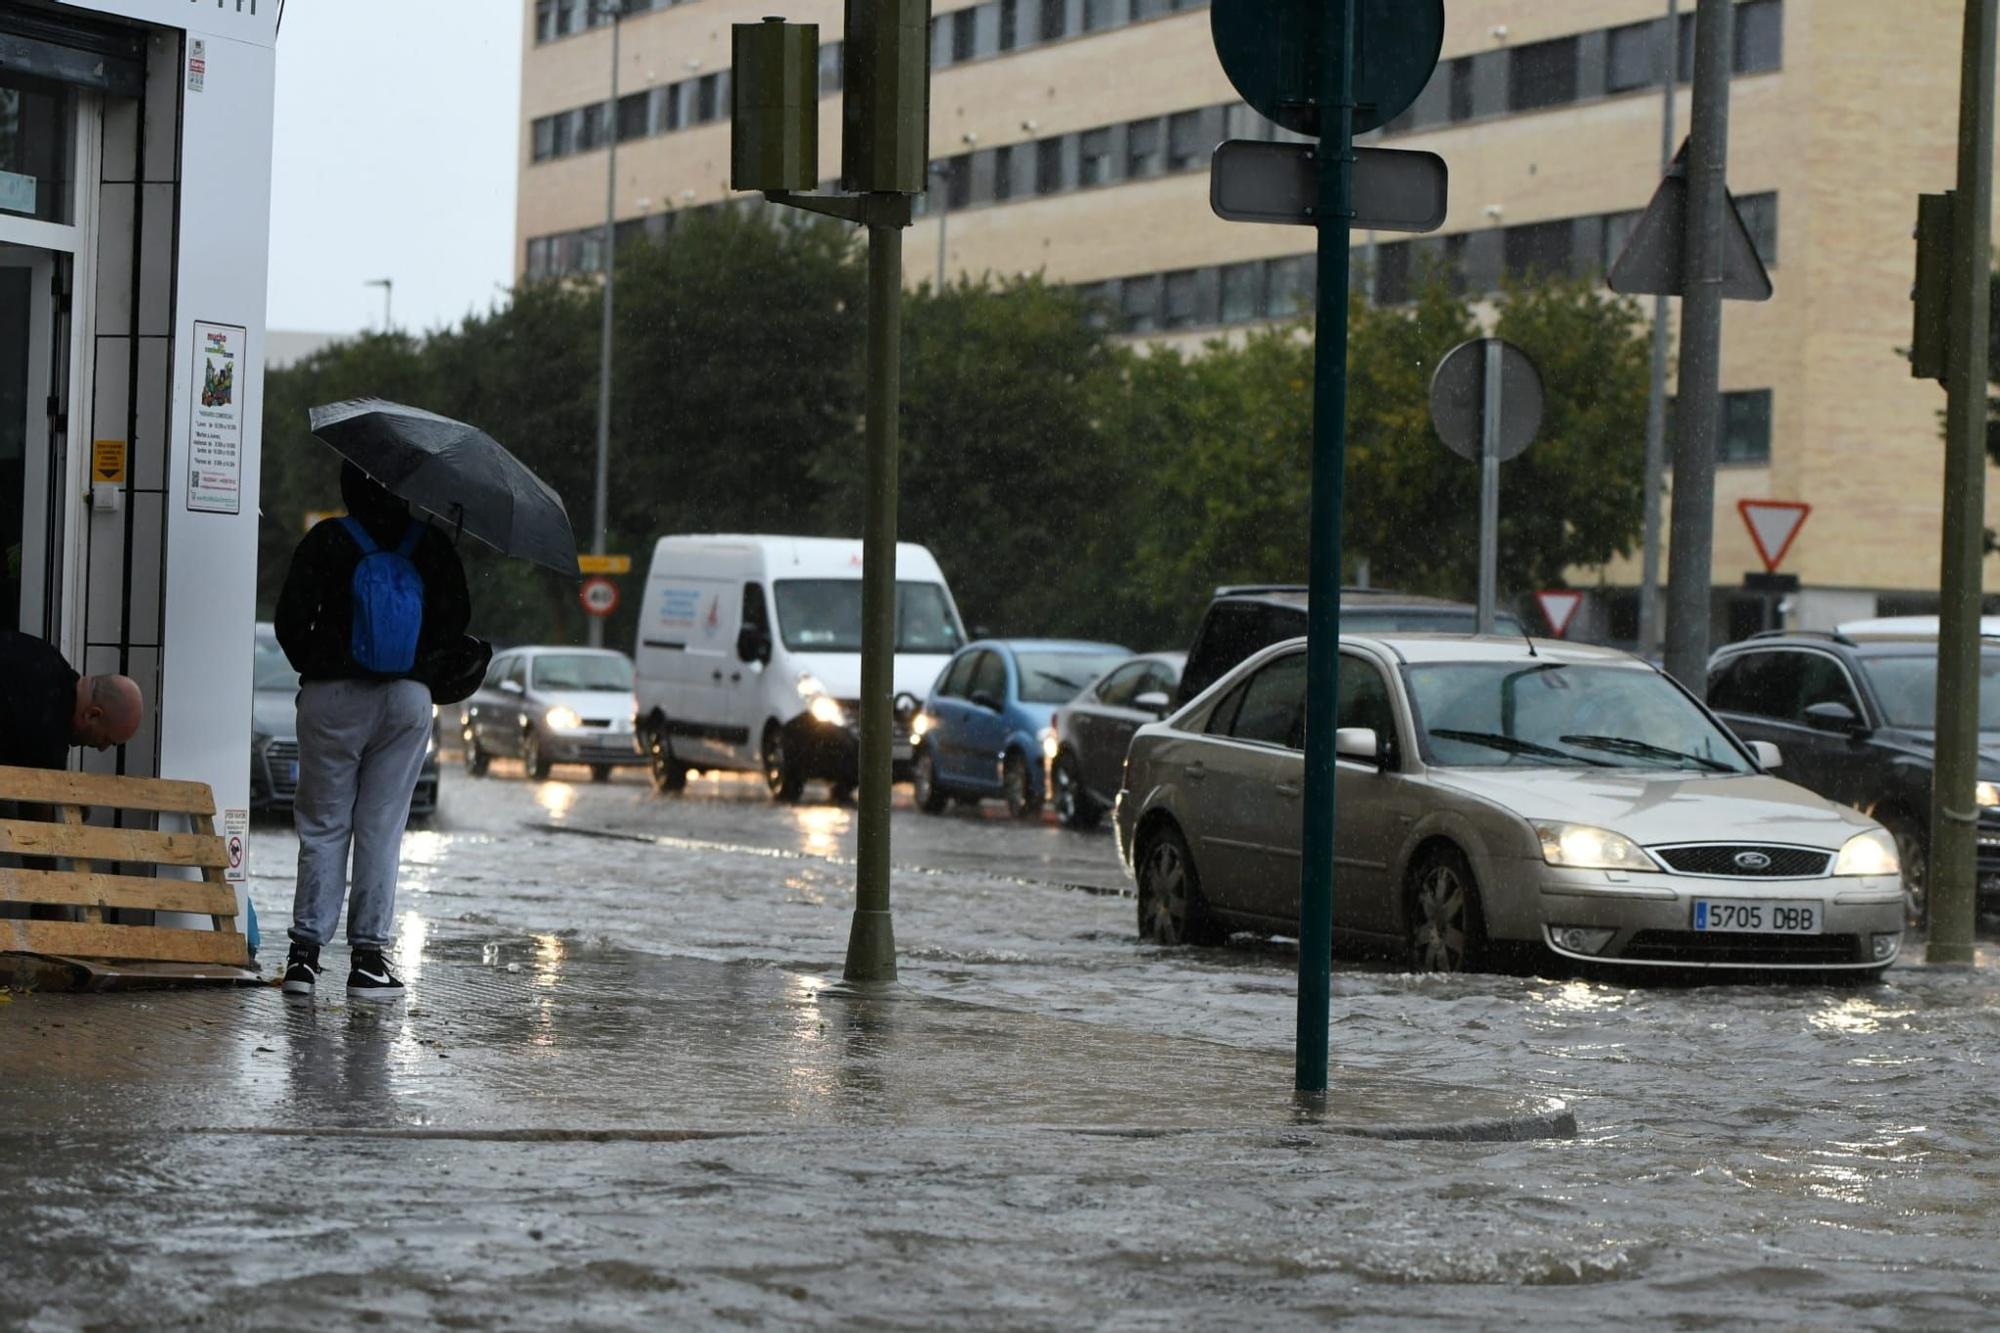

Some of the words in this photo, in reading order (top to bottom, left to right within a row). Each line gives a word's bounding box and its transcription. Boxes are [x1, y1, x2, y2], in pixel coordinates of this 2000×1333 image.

[590, 589, 610, 603] 40
[1710, 905, 1762, 928] 5705
[1773, 907, 1813, 930] DBB
